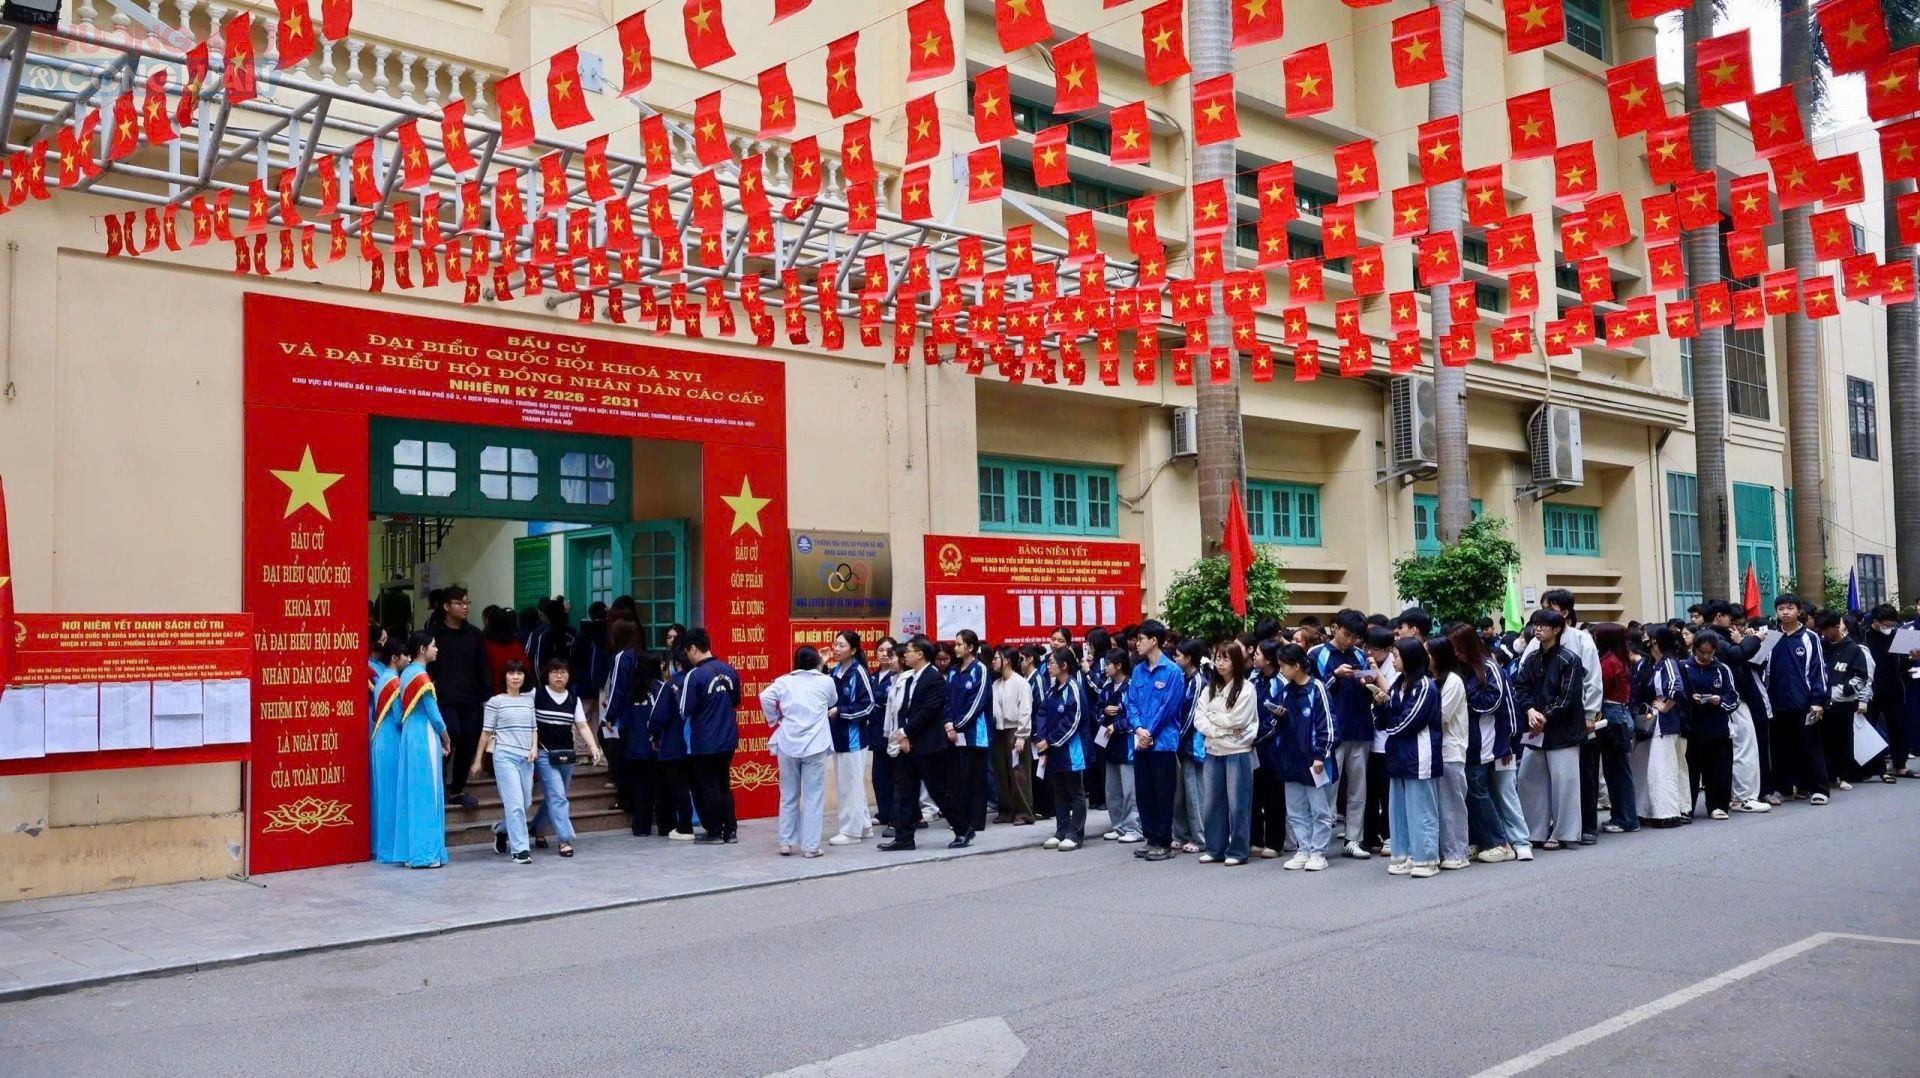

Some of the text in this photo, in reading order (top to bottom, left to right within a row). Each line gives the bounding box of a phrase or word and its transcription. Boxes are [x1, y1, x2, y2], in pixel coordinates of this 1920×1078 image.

[508, 336, 587, 354] BẦU CỬ
[368, 334, 703, 383] ĐẠI BIỂU QUỐC HỘI KHOÁ XVI
[279, 342, 764, 405] VÀ ĐẠI BIỂU HỘI ĐỒNG NHÂN DÂN CÁC CẤP
[308, 378, 321, 386] VỰC
[334, 380, 354, 389] PHIẾU
[355, 382, 365, 390] SỐ
[394, 386, 407, 395] CÁC
[432, 391, 445, 399] PHỐ
[446, 391, 455, 400] SỐ
[449, 379, 510, 395] NHIỆM
[516, 386, 538, 398] KỲ
[544, 389, 584, 402] 2026
[601, 395, 639, 408] 2031
[522, 415, 540, 423] THÀNH
[541, 416, 553, 424] PHỐ
[291, 523, 324, 550] BẦU CỬ
[735, 538, 759, 560] BẦU CỬ
[1018, 544, 1088, 557] BẢNG NIÊM YẾT
[263, 554, 351, 588] ĐẠI BIỂU QUỐC HỘI
[731, 566, 763, 588] GÓP PHẦN
[285, 594, 331, 617] KHOÁ XVI
[731, 596, 764, 618] XÂY DỰNG
[62, 619, 224, 630] NƠI NIÊM YẾT DANH SÁCH CỬ TRI
[732, 624, 765, 642] NHÀ NƯỚC
[795, 630, 805, 643] NƠI
[806, 630, 822, 643] NIÊM
[823, 628, 833, 643] YẾT
[866, 627, 875, 642] CỬ
[254, 621, 359, 655] VÀ ĐẠI BIỂU HỘI ĐỒNG
[728, 648, 769, 670] PHÁP QUYỀN
[262, 657, 352, 685] NHÂN DÂN CÁC CẤP
[744, 677, 757, 697] CHỦ
[260, 696, 292, 724] NHIỆM
[295, 696, 308, 718] KỲ
[310, 701, 330, 718] 2026
[337, 700, 354, 716] 2031
[751, 711, 765, 724] NAM
[278, 728, 338, 754] LÀ NGÀY HỘI
[748, 737, 768, 755] MẠNH
[271, 762, 290, 788] CỦA
[292, 763, 319, 787] TOÀN
[321, 761, 341, 784] DÂN
